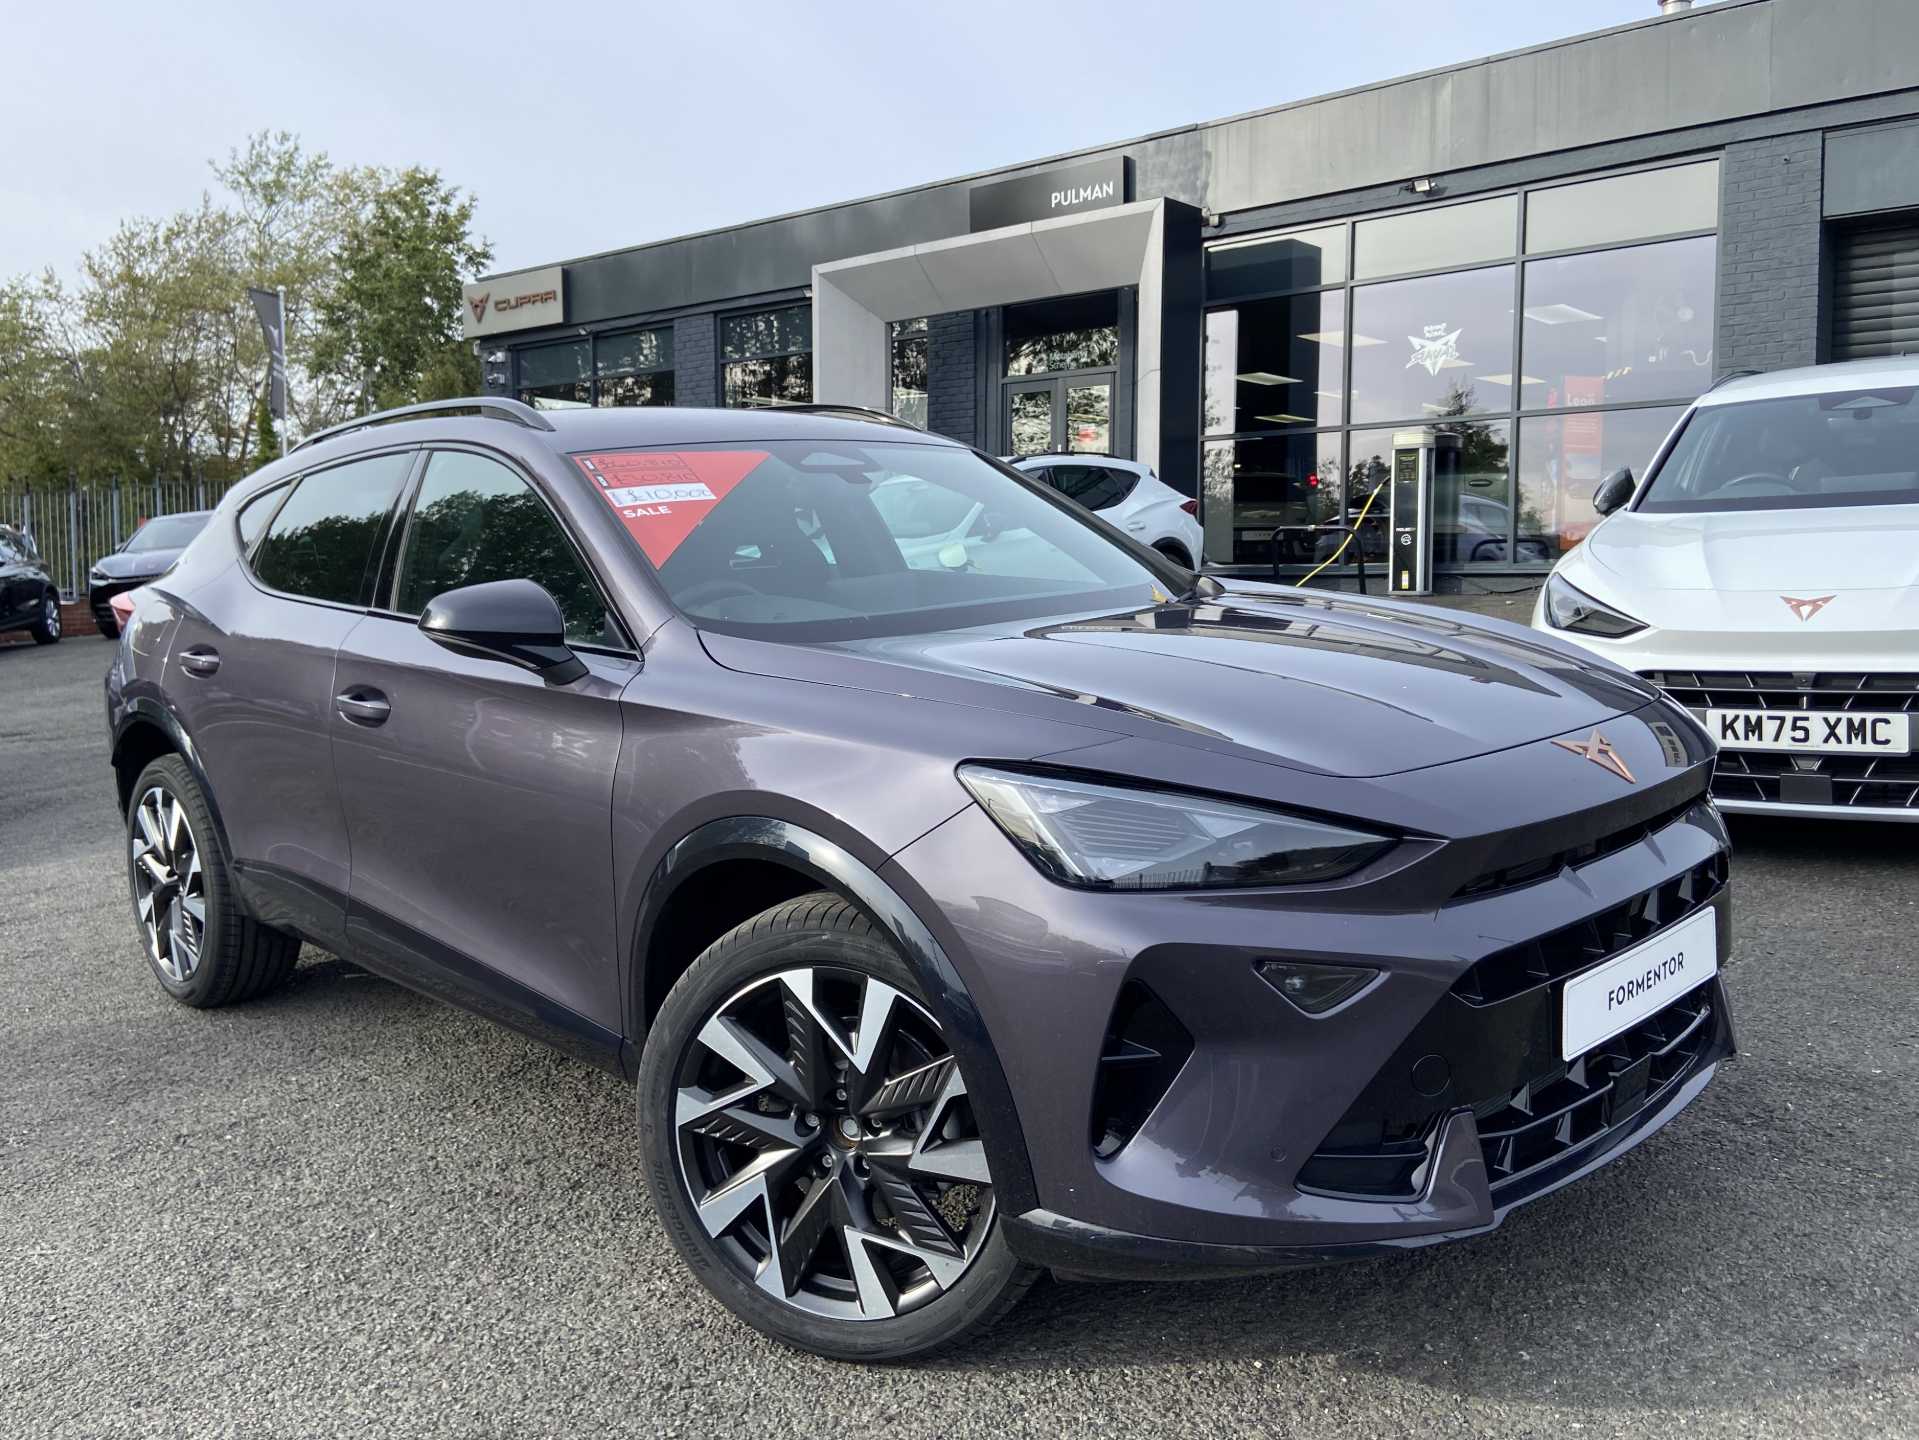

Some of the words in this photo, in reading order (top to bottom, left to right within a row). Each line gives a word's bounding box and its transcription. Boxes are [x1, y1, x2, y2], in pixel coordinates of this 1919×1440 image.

[1051, 181, 1113, 208] PULMAN
[494, 289, 557, 312] CUPRA
[623, 505, 672, 518] SALE
[1721, 714, 1810, 743] KM75
[1822, 717, 1891, 745] XMC
[1608, 951, 1684, 1011] FORMENTOR
